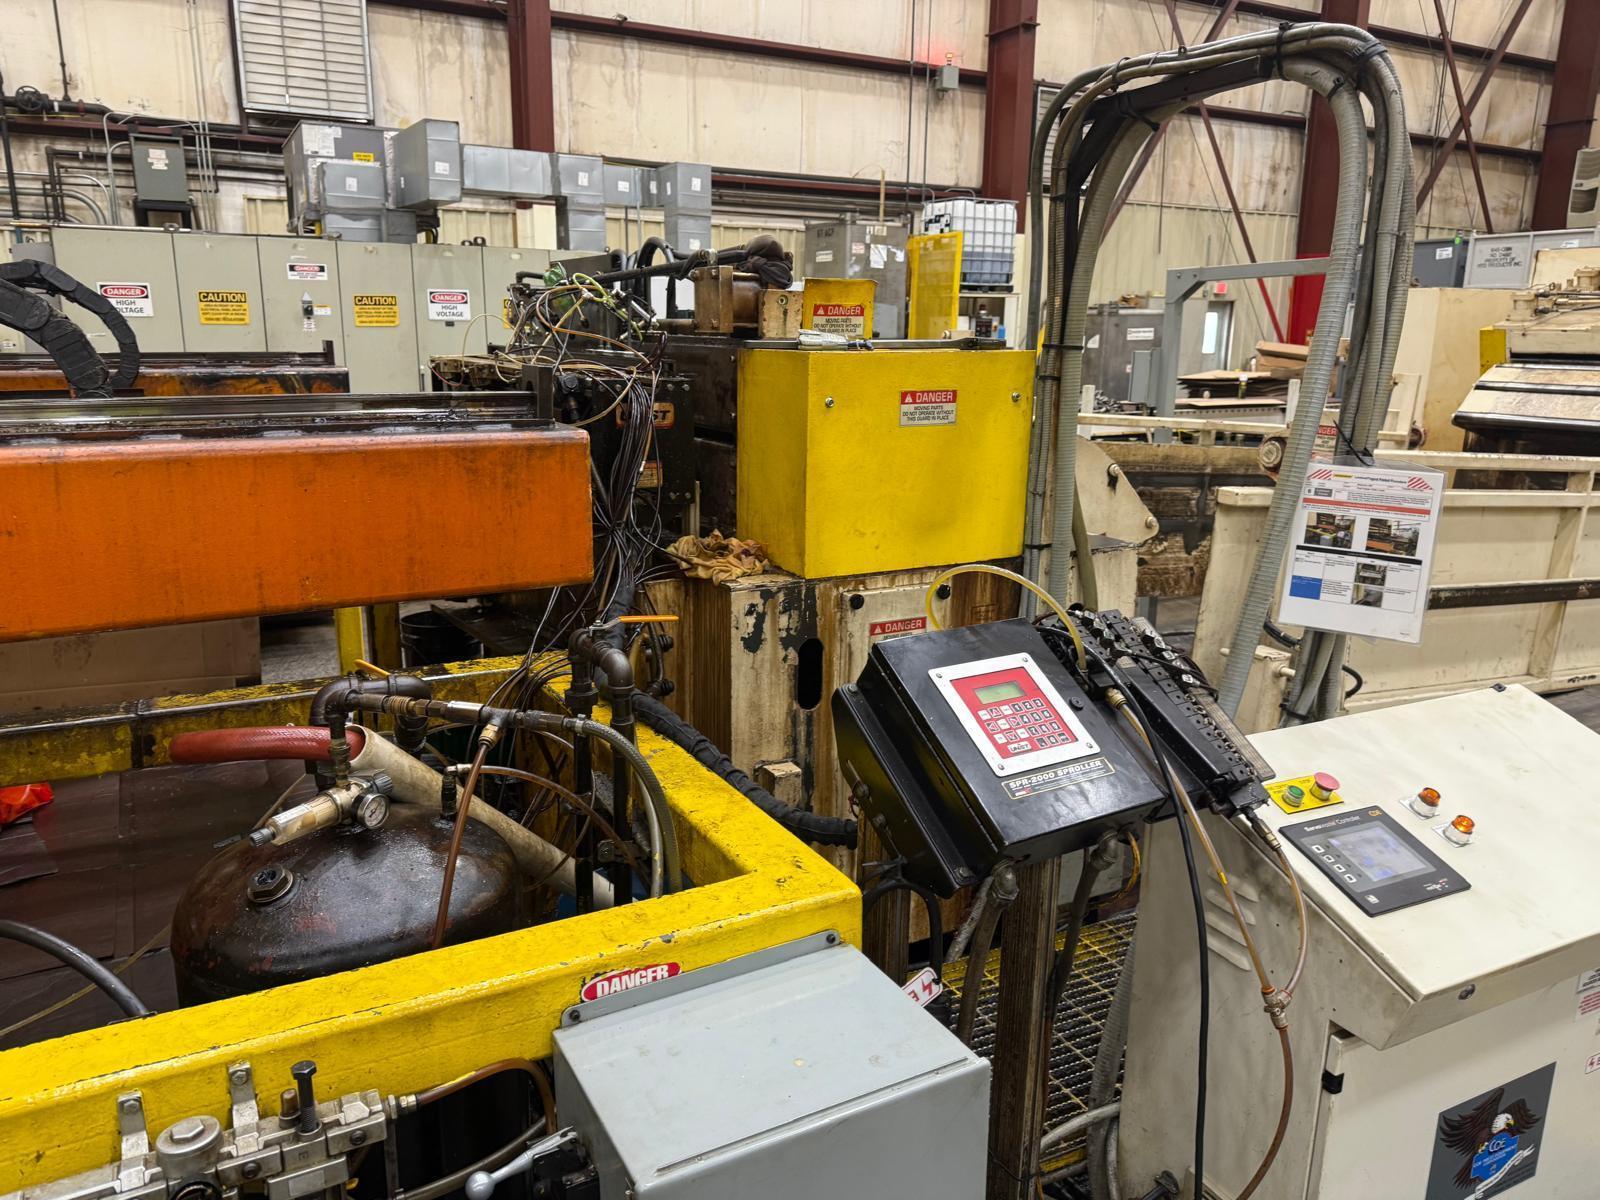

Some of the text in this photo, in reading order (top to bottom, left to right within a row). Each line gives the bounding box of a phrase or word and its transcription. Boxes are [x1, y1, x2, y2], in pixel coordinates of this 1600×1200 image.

[200, 292, 246, 302] CAUTION
[355, 296, 396, 305] CAUTION
[828, 306, 861, 315] DANGER
[916, 392, 953, 402] DANGER
[885, 620, 922, 632] DANGER
[1009, 772, 1055, 789] SPR-2000
[1057, 760, 1102, 776] SPROLLER
